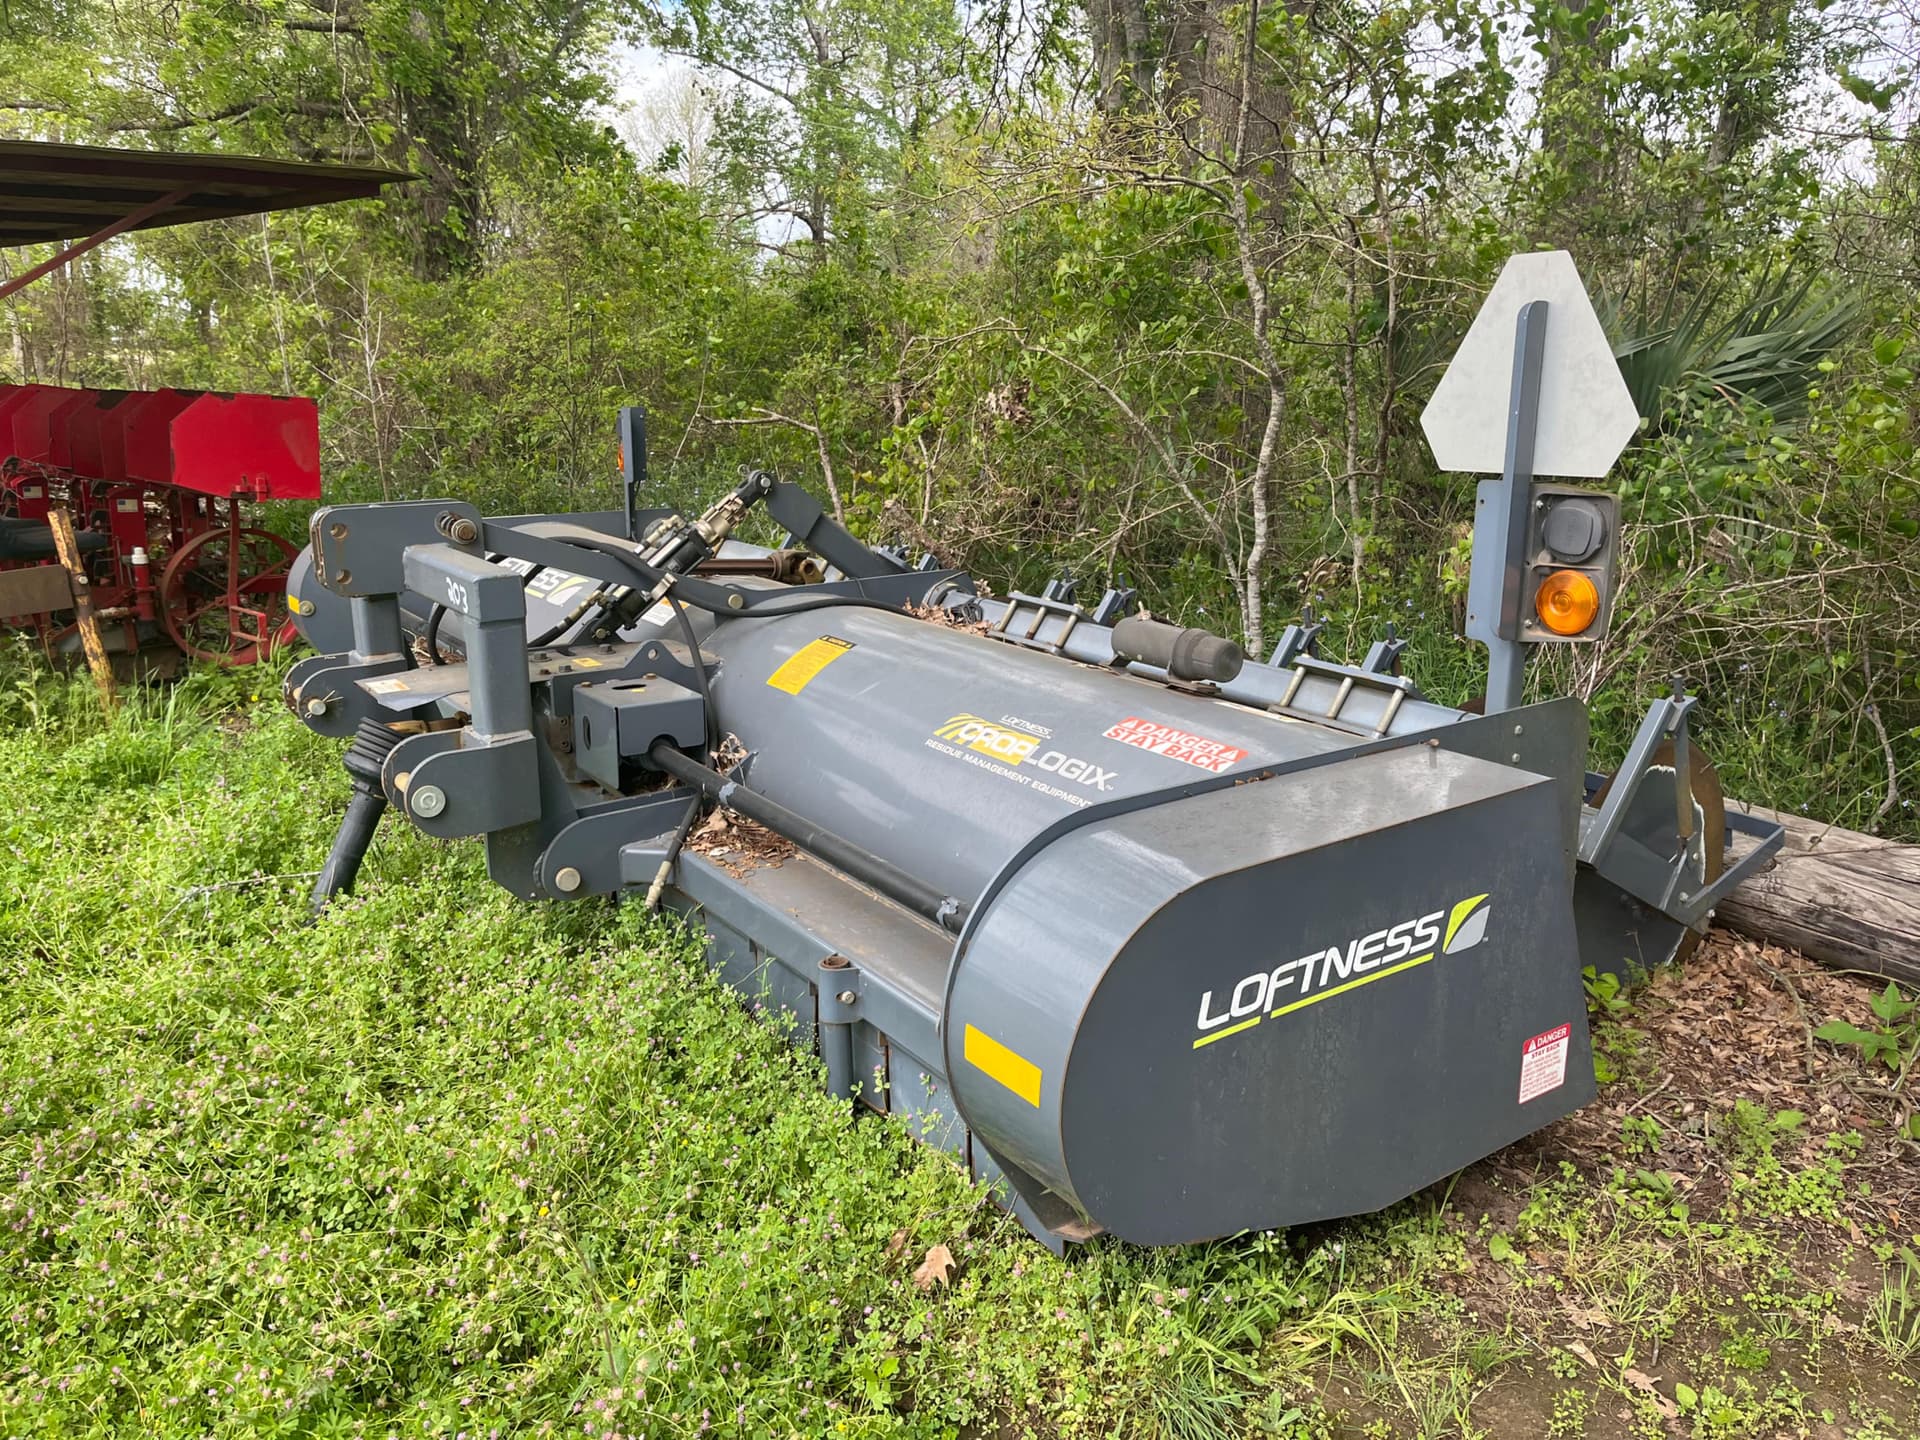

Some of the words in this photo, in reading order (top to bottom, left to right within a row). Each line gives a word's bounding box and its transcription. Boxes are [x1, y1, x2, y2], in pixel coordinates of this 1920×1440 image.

[445, 576, 469, 614] 203
[1000, 714, 1053, 736] LOFTNESS
[1139, 722, 1221, 757] DANGER
[924, 738, 965, 760] RESIDUE
[962, 753, 1032, 786] MANAGEMENT
[1106, 727, 1165, 750] STAY
[1161, 744, 1227, 772] BACK
[1197, 909, 1445, 1031] LOFTNESS
[1531, 1049, 1545, 1059] STAY
[1536, 1027, 1567, 1048] DANGER
